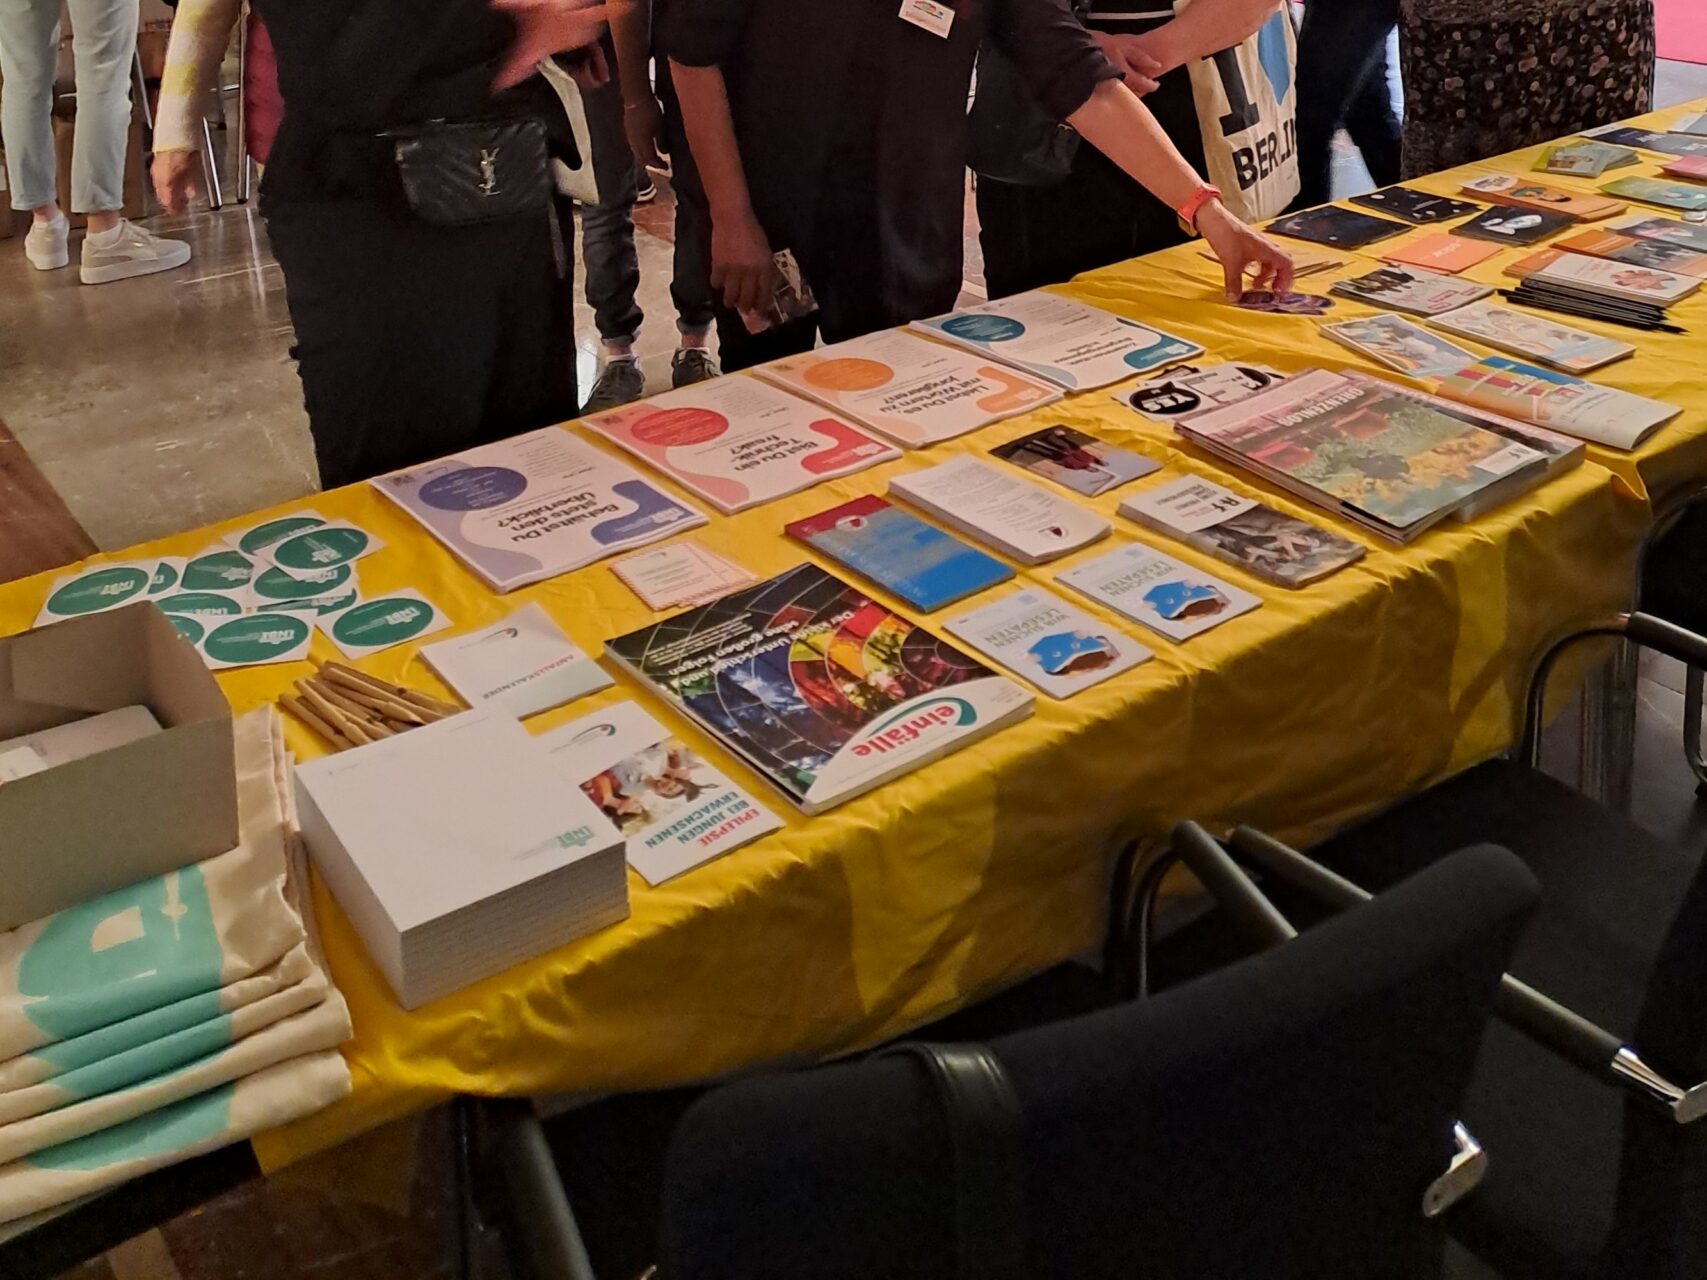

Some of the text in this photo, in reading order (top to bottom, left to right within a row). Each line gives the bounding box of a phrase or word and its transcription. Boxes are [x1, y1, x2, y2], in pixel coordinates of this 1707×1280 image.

[960, 376, 982, 388] mit
[879, 402, 898, 414] zu
[925, 398, 945, 410] Du
[1142, 393, 1195, 412] YES
[729, 434, 781, 455] freak?
[730, 437, 802, 463] Technik-
[734, 441, 819, 471] Bist Du ein
[498, 491, 597, 528] Überblick?
[512, 500, 599, 532] stets den
[543, 504, 620, 534] Behältst
[512, 531, 542, 542] Du
[765, 620, 800, 638] seine
[830, 611, 855, 624] Der
[984, 607, 1061, 645] LESEPATEN
[711, 637, 791, 674] Unterschied
[715, 631, 764, 658] großen
[668, 648, 720, 676] Folgen
[680, 669, 710, 687] und
[850, 704, 956, 757] einfälle
[644, 791, 740, 849] ERWACHSENEN
[676, 799, 750, 845] BEI JUNGEN
[699, 807, 760, 848] EPILEPSIE
